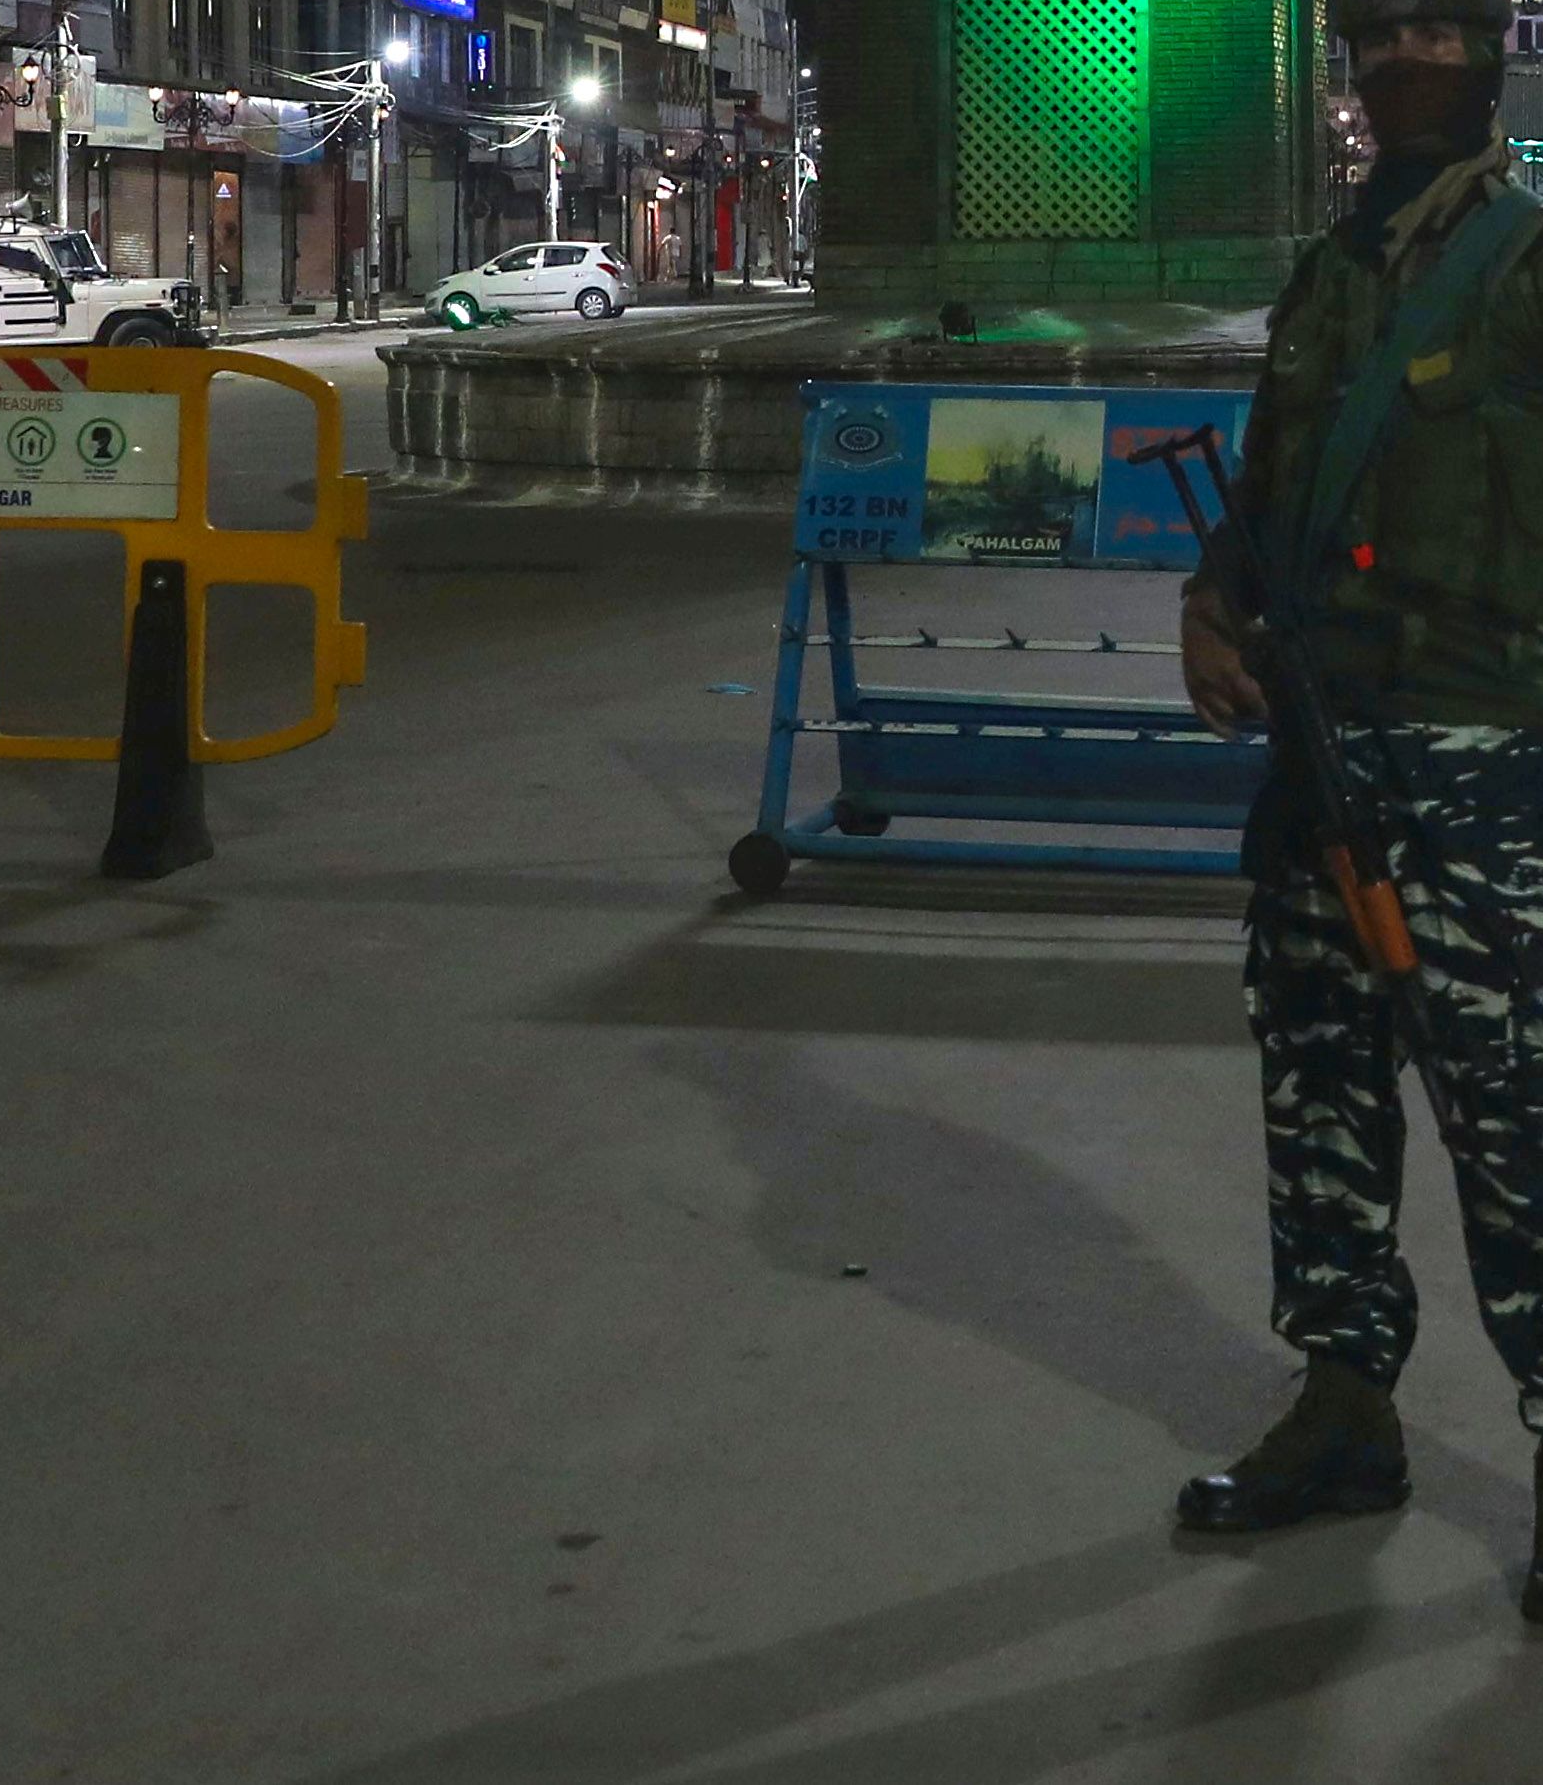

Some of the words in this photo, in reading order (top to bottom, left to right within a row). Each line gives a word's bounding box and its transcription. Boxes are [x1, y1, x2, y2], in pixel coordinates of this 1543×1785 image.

[805, 495, 855, 517] 132
[866, 496, 907, 518] BN
[817, 527, 897, 550] CRPF
[962, 535, 1062, 552] PAHALGAM
